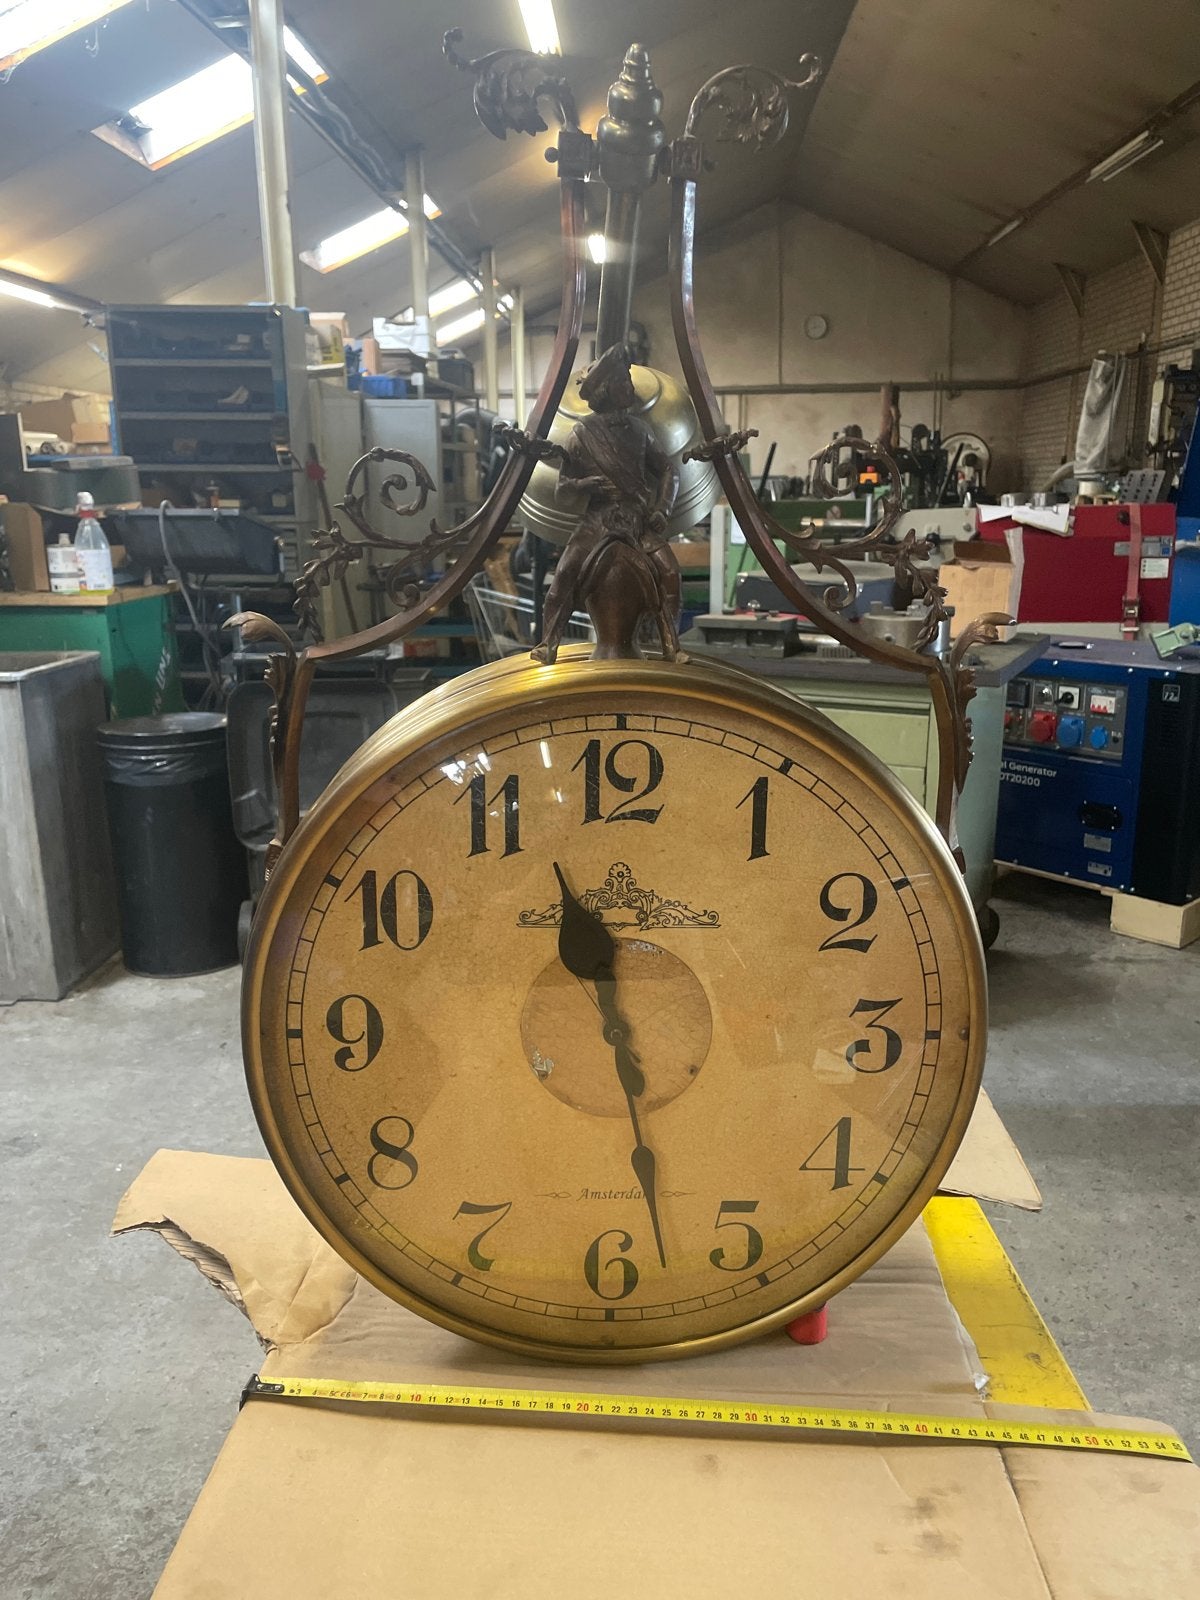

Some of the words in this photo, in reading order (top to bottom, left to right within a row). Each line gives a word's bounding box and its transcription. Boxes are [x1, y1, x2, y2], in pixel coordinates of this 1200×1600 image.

[571, 739, 664, 825] 12
[1008, 761, 1058, 778] Generator
[453, 774, 525, 859] 11
[735, 776, 771, 862] 1
[344, 869, 434, 951] 10
[818, 872, 878, 954] 2
[326, 994, 384, 1072] 9
[845, 997, 904, 1073] 3
[367, 1115, 419, 1190] 8
[798, 1116, 866, 1191] 4
[452, 1200, 513, 1271] 7
[583, 1229, 639, 1300] 6
[708, 1200, 764, 1271] 5
[410, 1393, 421, 1402] 10
[428, 1395, 436, 1403] 11
[478, 1398, 487, 1406] 14
[511, 1400, 520, 1408] 16
[545, 1401, 554, 1409] 18
[562, 1402, 571, 1410] 19
[576, 1403, 589, 1412] 20
[595, 1404, 604, 1412] 21
[611, 1405, 621, 1413] 22
[628, 1406, 637, 1414] 23
[645, 1407, 654, 1415] 24
[662, 1408, 671, 1416] 25
[679, 1409, 688, 1417] 26
[696, 1410, 705, 1418] 27
[712, 1412, 722, 1420] 28
[744, 1412, 758, 1422] 30
[780, 1416, 790, 1424] 32
[797, 1417, 807, 1425] 33
[831, 1419, 841, 1427] 35
[848, 1420, 858, 1428] 36
[865, 1421, 875, 1429] 37
[882, 1423, 892, 1431] 38
[899, 1424, 909, 1432] 39
[915, 1424, 928, 1433] 40
[933, 1426, 943, 1434] 41
[951, 1428, 960, 1436] 42
[968, 1429, 978, 1437] 43
[985, 1430, 995, 1439] 44
[1002, 1431, 1012, 1440] 45
[1019, 1433, 1029, 1441] 46
[1036, 1434, 1046, 1442] 47
[1053, 1435, 1063, 1443] 48
[1070, 1436, 1081, 1444] 49
[1085, 1436, 1099, 1446] 50
[1103, 1438, 1114, 1447] 51
[1121, 1439, 1131, 1448] 52
[1138, 1440, 1149, 1449] 53
[1155, 1441, 1166, 1450] 54
